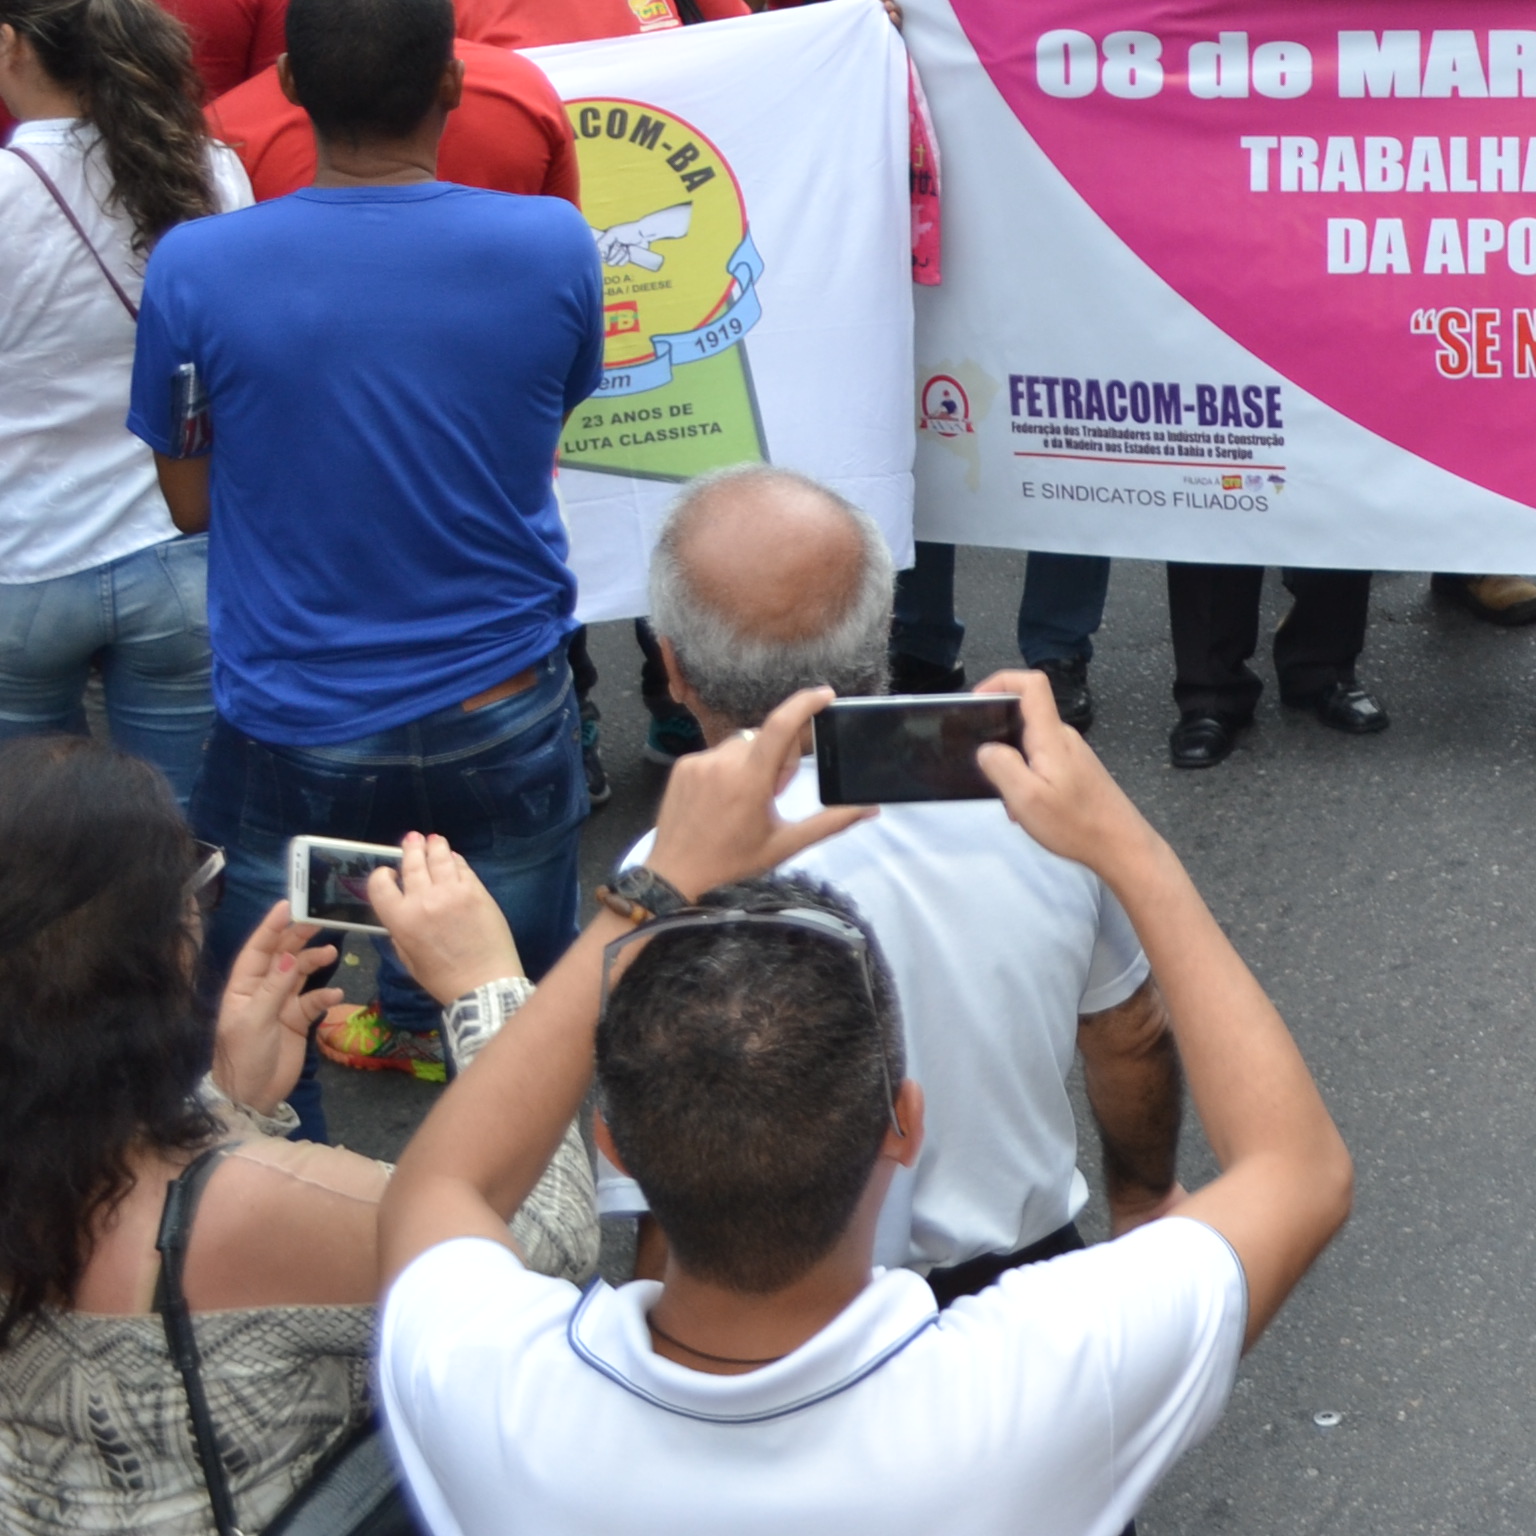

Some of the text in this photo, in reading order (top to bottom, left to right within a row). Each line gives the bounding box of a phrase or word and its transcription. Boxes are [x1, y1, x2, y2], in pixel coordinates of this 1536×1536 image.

[1034, 28, 1165, 100] 08
[1187, 30, 1312, 99] de
[1327, 216, 1411, 275] DA
[632, 280, 672, 293] DIEESE
[694, 317, 743, 353] 1919
[582, 403, 693, 429] 23 ANOS DE
[1008, 374, 1284, 429] FETRACOM-BASE
[564, 422, 722, 453] LUTA CLASSISTA
[1011, 421, 1062, 437] Federação
[1064, 425, 1080, 436] dos
[1082, 426, 1150, 442] Trabalhadores
[1153, 431, 1165, 441] na
[1213, 432, 1225, 444] da
[1228, 433, 1284, 448] Construção
[1022, 482, 1269, 513] E SINDICATOS FILIADOS
